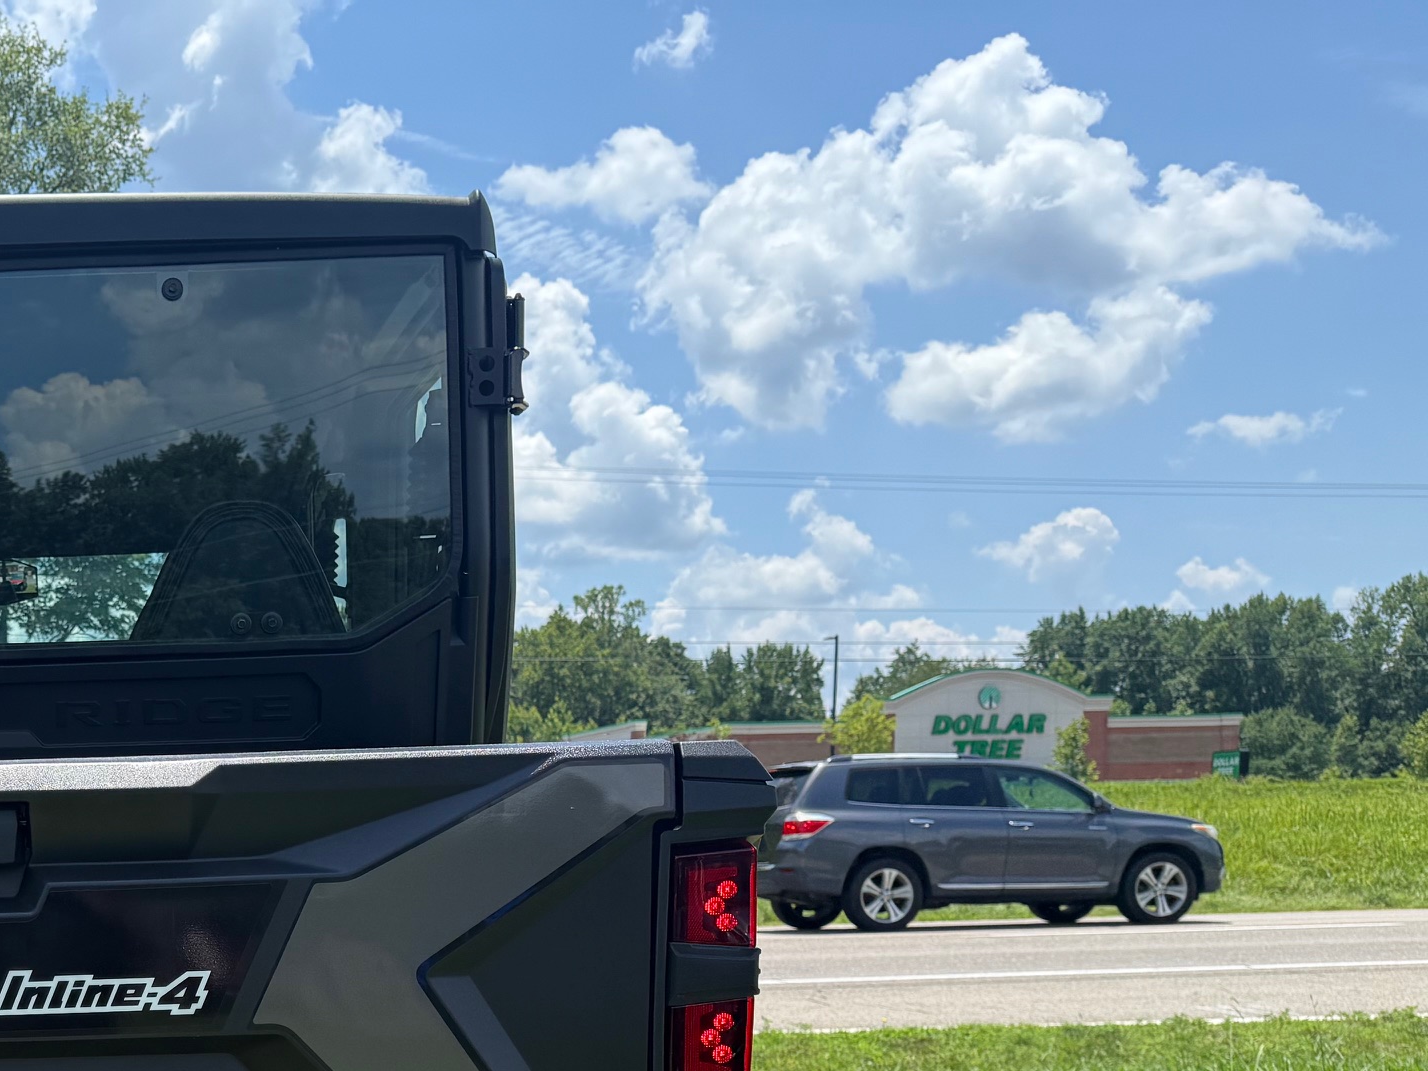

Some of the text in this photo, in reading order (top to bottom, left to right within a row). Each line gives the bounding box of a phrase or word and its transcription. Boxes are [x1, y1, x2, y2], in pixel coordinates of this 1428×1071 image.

[55, 695, 293, 728] RIDGE
[931, 713, 1047, 736] DOLLAR
[953, 738, 1025, 759] TREE
